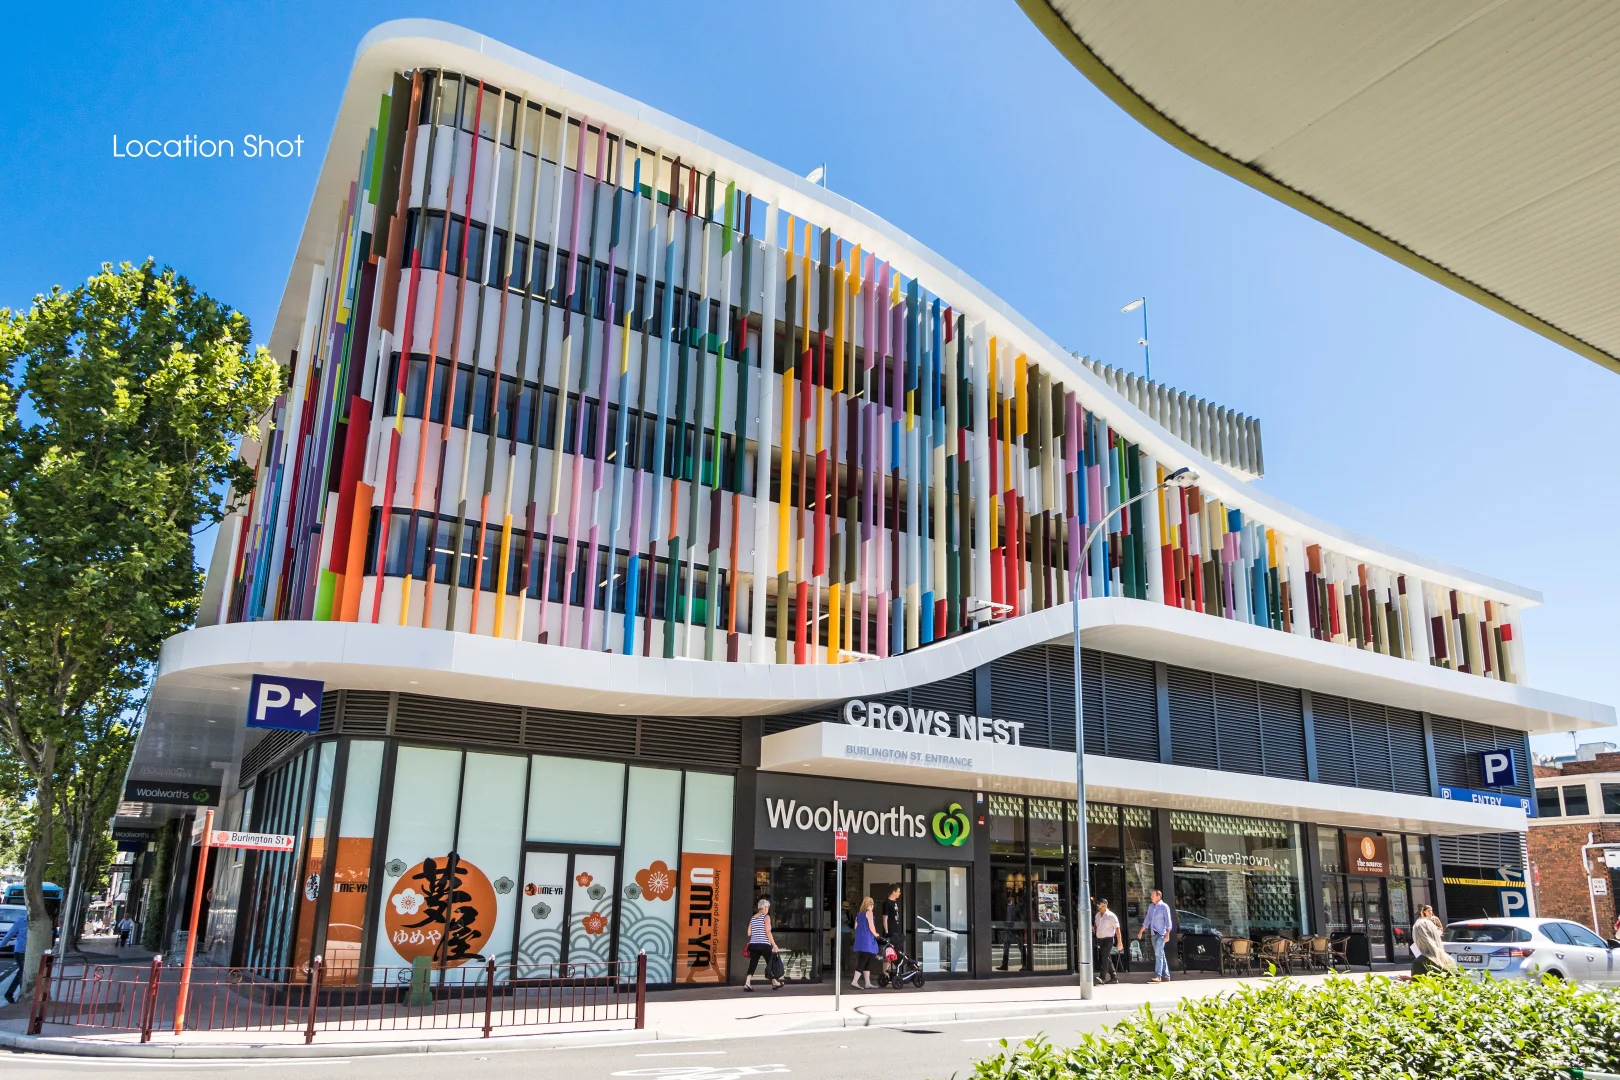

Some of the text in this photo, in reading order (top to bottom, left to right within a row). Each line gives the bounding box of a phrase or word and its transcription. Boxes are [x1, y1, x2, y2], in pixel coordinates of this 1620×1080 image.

[256, 683, 290, 720] P
[844, 700, 1025, 746] CROWS NEST
[845, 744, 908, 760] BURLINGTON
[925, 753, 973, 767] ENTRANCE
[1484, 754, 1508, 783] P
[136, 788, 189, 799] Woolworths
[1471, 794, 1502, 806] ENTRY
[766, 798, 927, 838] Woolworths
[231, 833, 273, 845] Burlington
[275, 836, 285, 845] St
[1356, 857, 1366, 867] the
[334, 883, 368, 893] UME-YA
[537, 886, 564, 895] UME-YA
[687, 867, 714, 968] UME-YA
[712, 917, 720, 937] Asian
[393, 929, 442, 946] ゆめや
[711, 938, 719, 966] Grocery
